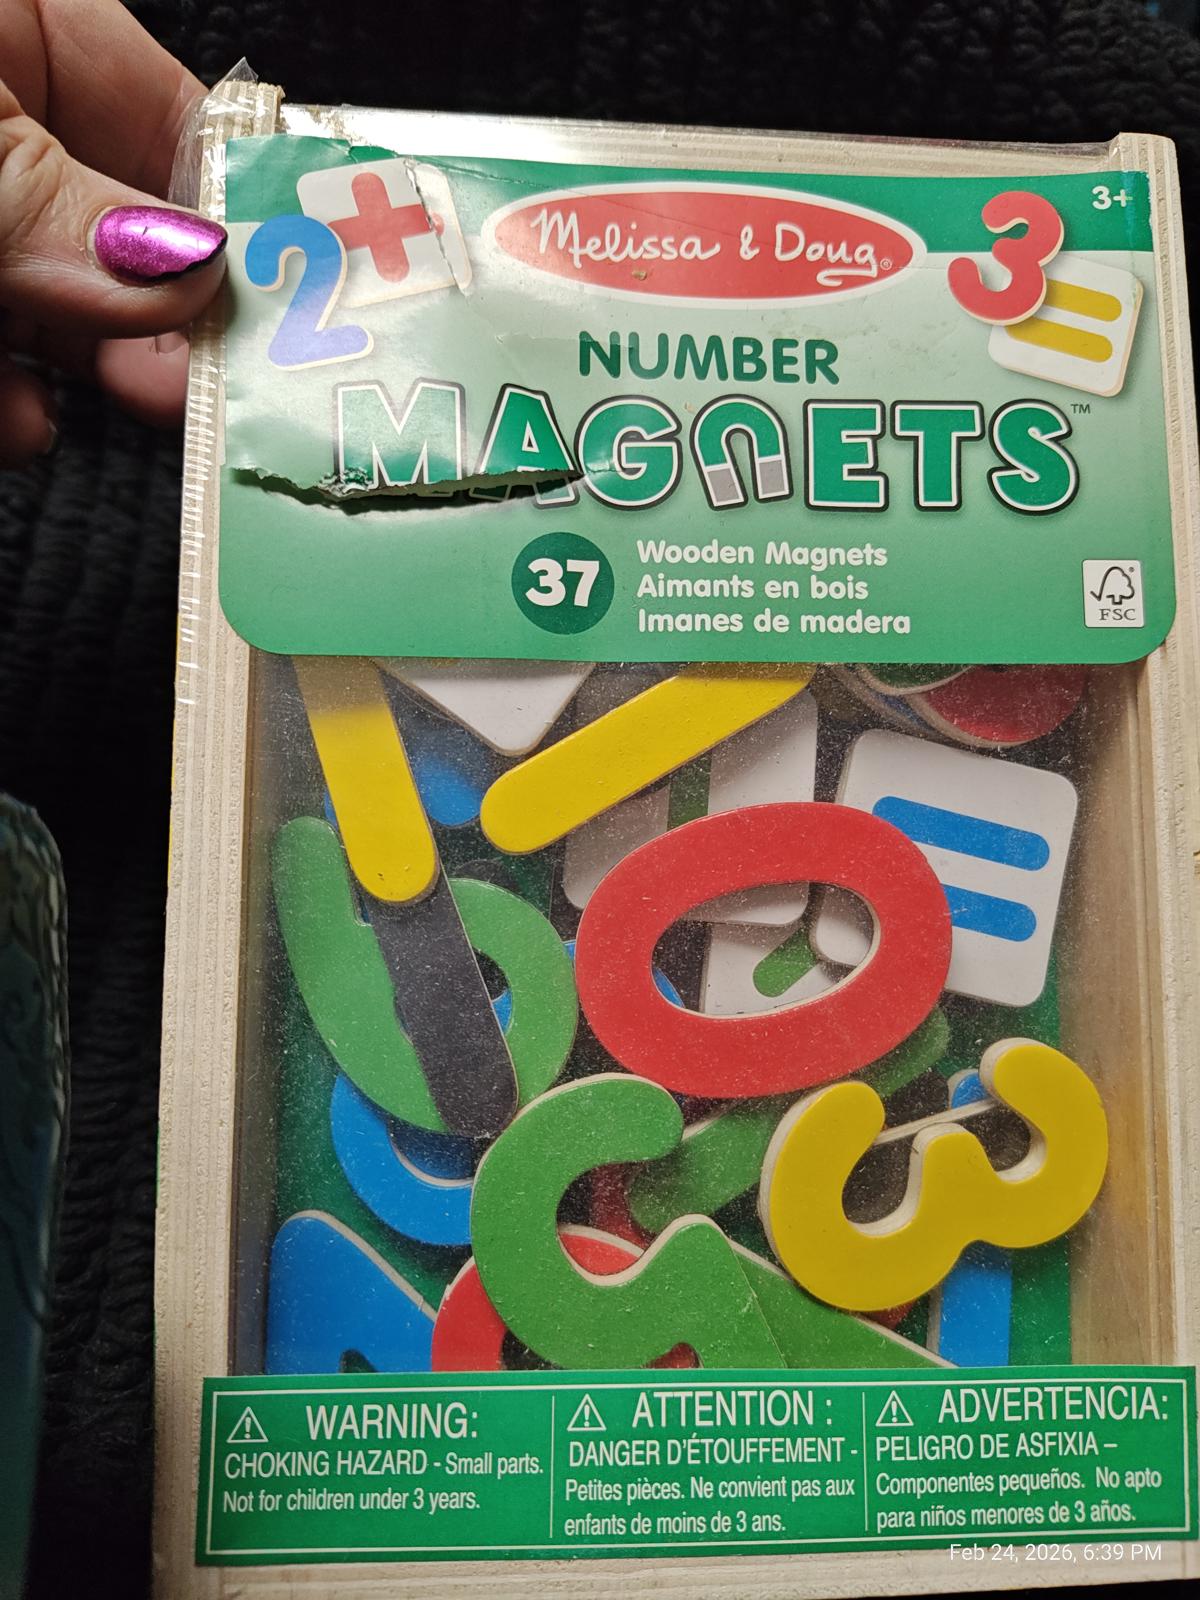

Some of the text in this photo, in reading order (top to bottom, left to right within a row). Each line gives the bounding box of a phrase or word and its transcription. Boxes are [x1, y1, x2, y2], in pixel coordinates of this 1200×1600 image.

[1092, 185, 1133, 210] 3+
[530, 208, 721, 269] Melissa
[739, 224, 760, 261] &
[579, 330, 839, 385] NUMBER
[333, 376, 1080, 514] MAGNETS
[636, 539, 888, 572] Wooden Magnets
[525, 557, 601, 607] 37
[637, 573, 869, 599] Aimants en bois
[638, 607, 911, 634] Imanes de madera
[1099, 608, 1136, 621] FSC
[632, 1390, 814, 1428] ATTENTION
[938, 1385, 1168, 1424] ADVERTENCIA:
[306, 1402, 478, 1441] WARNING:
[569, 1439, 660, 1468] DANGER
[876, 1434, 974, 1461] PELIGRO
[980, 1434, 1009, 1459] DE
[1015, 1431, 1099, 1457] ASFIXIA
[224, 1451, 329, 1479] CHOKING
[337, 1449, 428, 1475] HAZARD
[445, 1452, 492, 1475] Small
[497, 1454, 544, 1480] parts.
[565, 1475, 855, 1506] Petites pièces. Ne convient pas aux
[876, 1467, 1162, 1499] Componentes pequeños. No apto
[223, 1488, 480, 1515] Not for children under 3 years.
[877, 1499, 1136, 1534] para niños menores de 3 años.
[564, 1510, 786, 1536] enfants de moins de 3 ans.
